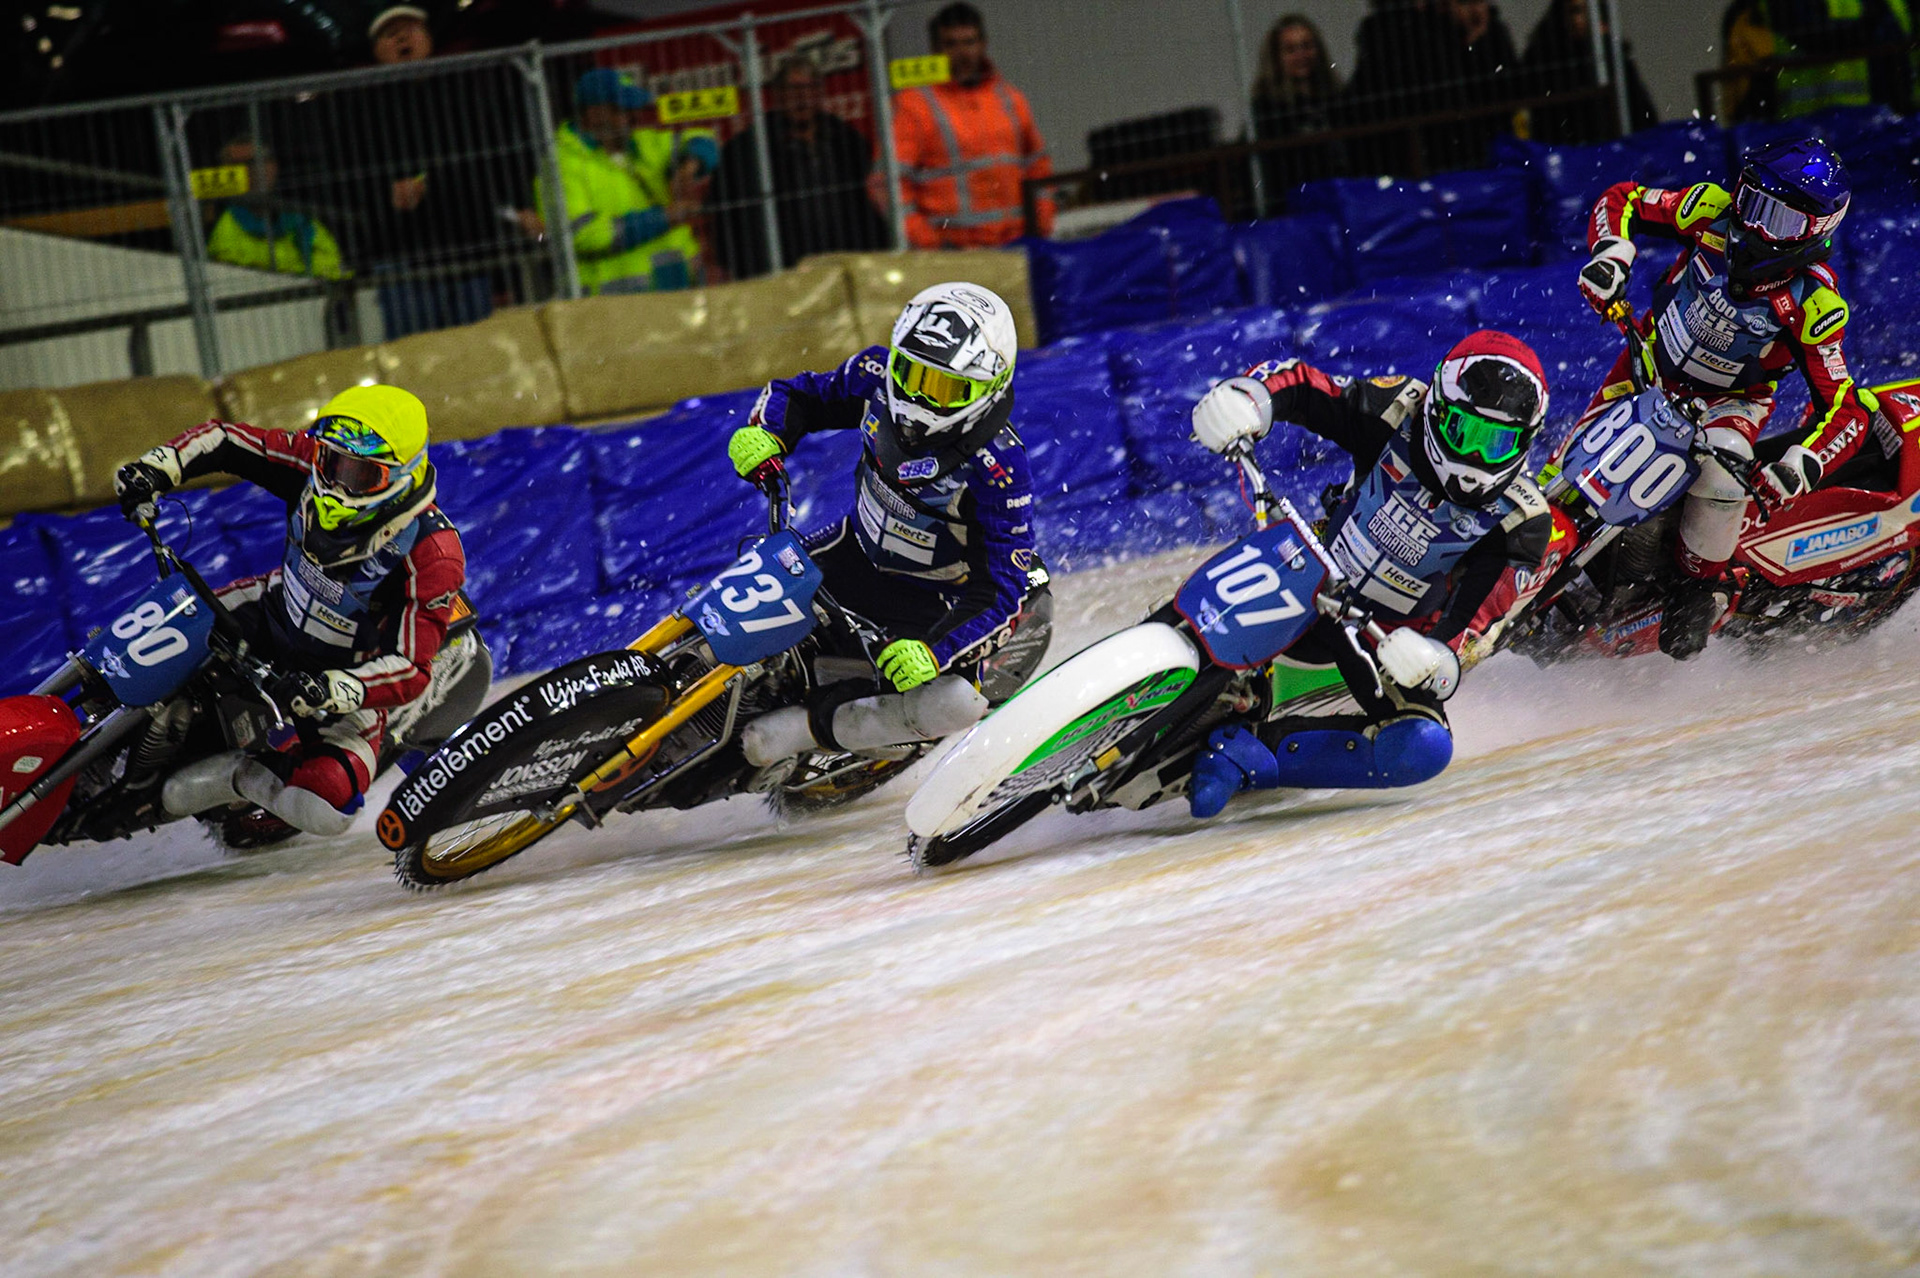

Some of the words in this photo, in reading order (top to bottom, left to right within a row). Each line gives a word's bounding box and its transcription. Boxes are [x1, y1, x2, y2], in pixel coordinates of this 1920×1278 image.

[1696, 290, 1743, 338] ICE
[1709, 288, 1737, 319] 800
[1699, 352, 1738, 371] Hertz
[1582, 400, 1687, 509] 800
[893, 522, 931, 543] Hertz
[1383, 490, 1442, 547] ICE
[1804, 523, 1869, 553] JAMABO
[710, 551, 806, 633] 237
[1206, 544, 1306, 627] 107
[1384, 567, 1424, 592] Hertz
[111, 601, 189, 667] 80
[318, 606, 351, 630] Hertz
[396, 700, 534, 823] lättelement
